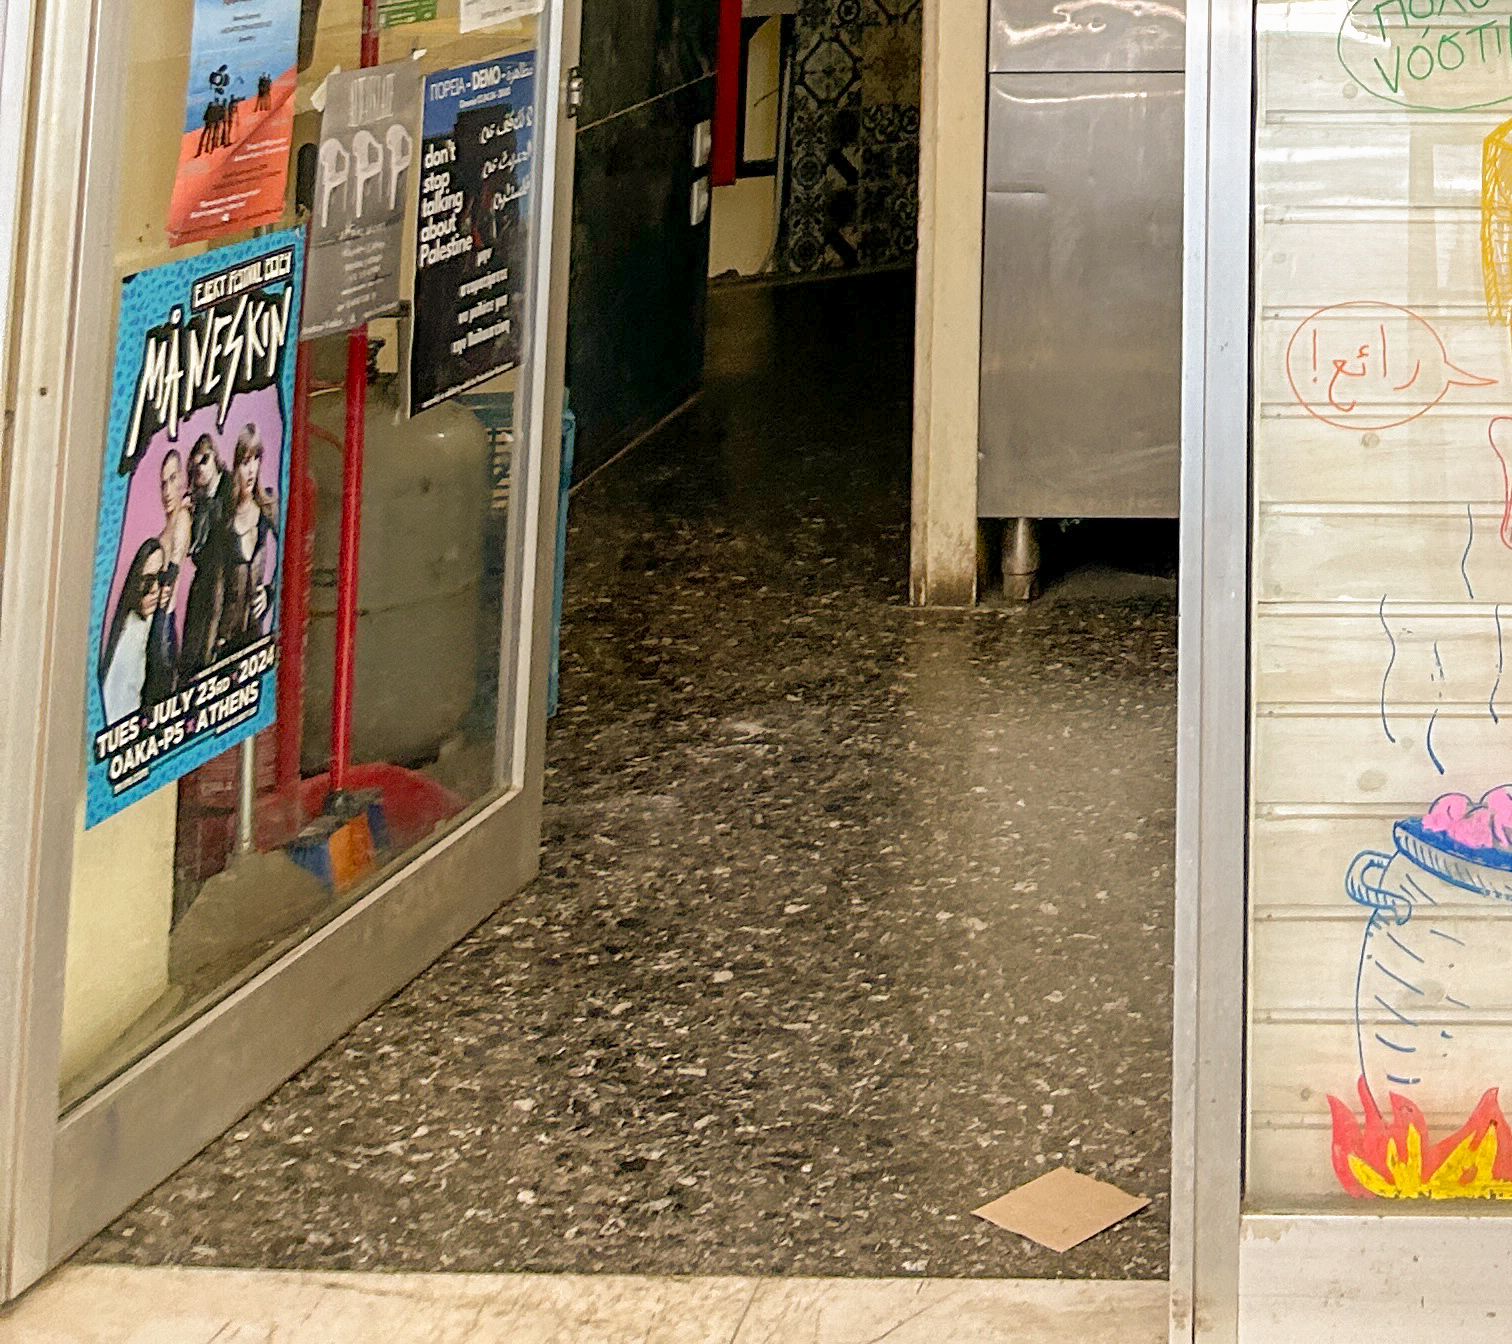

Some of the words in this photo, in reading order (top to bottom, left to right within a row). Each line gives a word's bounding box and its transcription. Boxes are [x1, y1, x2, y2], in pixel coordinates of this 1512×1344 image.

[471, 65, 501, 92] DEMO
[423, 138, 458, 170] don't
[423, 171, 451, 196] stop
[421, 187, 465, 218] talking
[420, 212, 458, 243] about
[418, 232, 474, 269] Palestine
[96, 715, 140, 759] TUES
[147, 686, 195, 730] JULY
[238, 644, 276, 684] 2024
[195, 679, 261, 733] ATHENS
